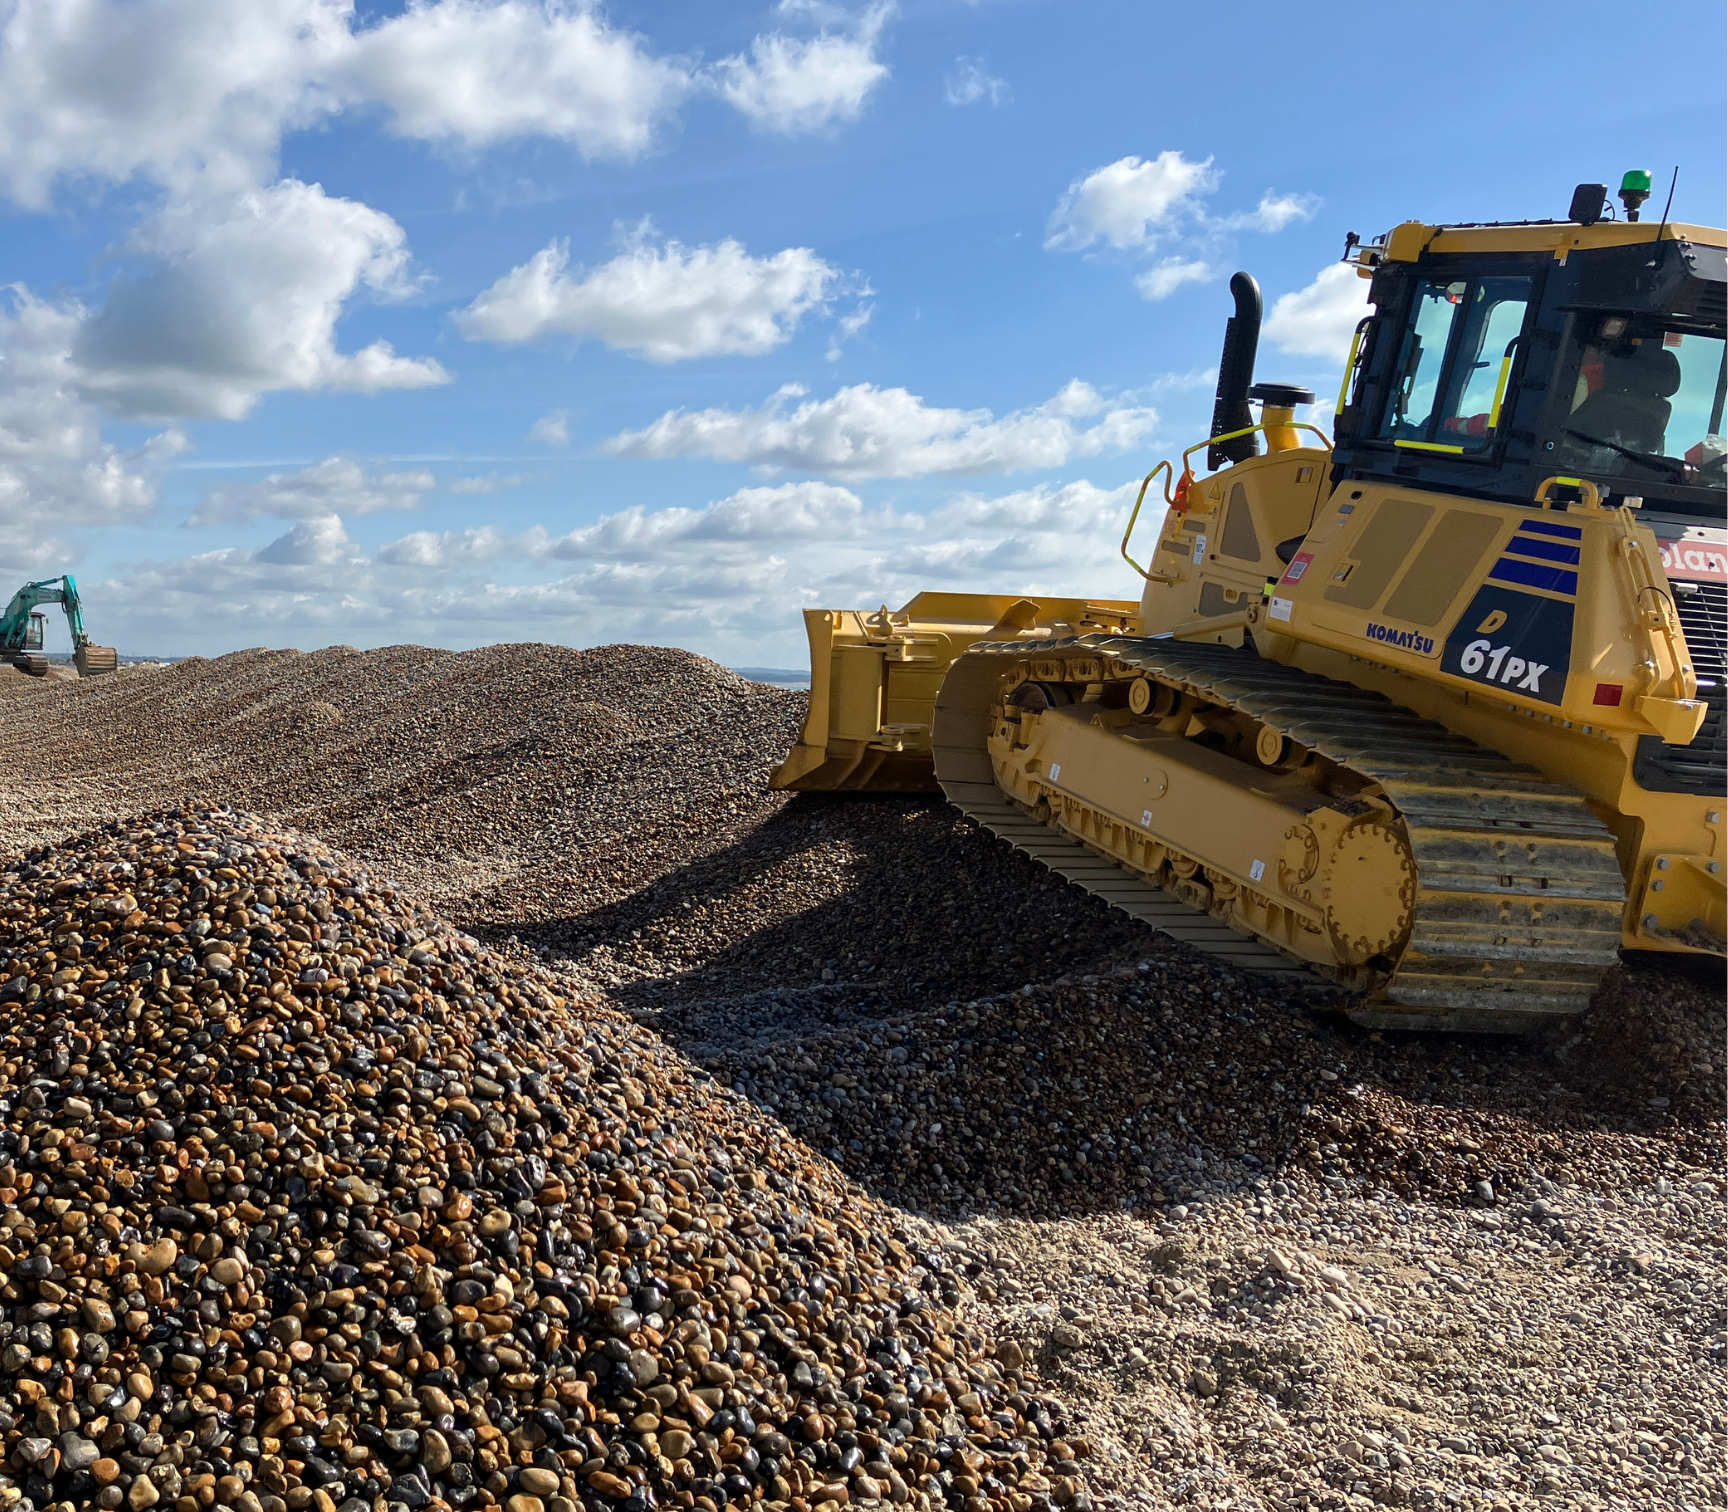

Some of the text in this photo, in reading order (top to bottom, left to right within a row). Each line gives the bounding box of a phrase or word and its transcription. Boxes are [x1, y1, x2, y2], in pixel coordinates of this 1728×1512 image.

[1476, 609, 1508, 634] D
[1366, 622, 1435, 654] KOMATSU
[1460, 639, 1550, 693] 61PX
